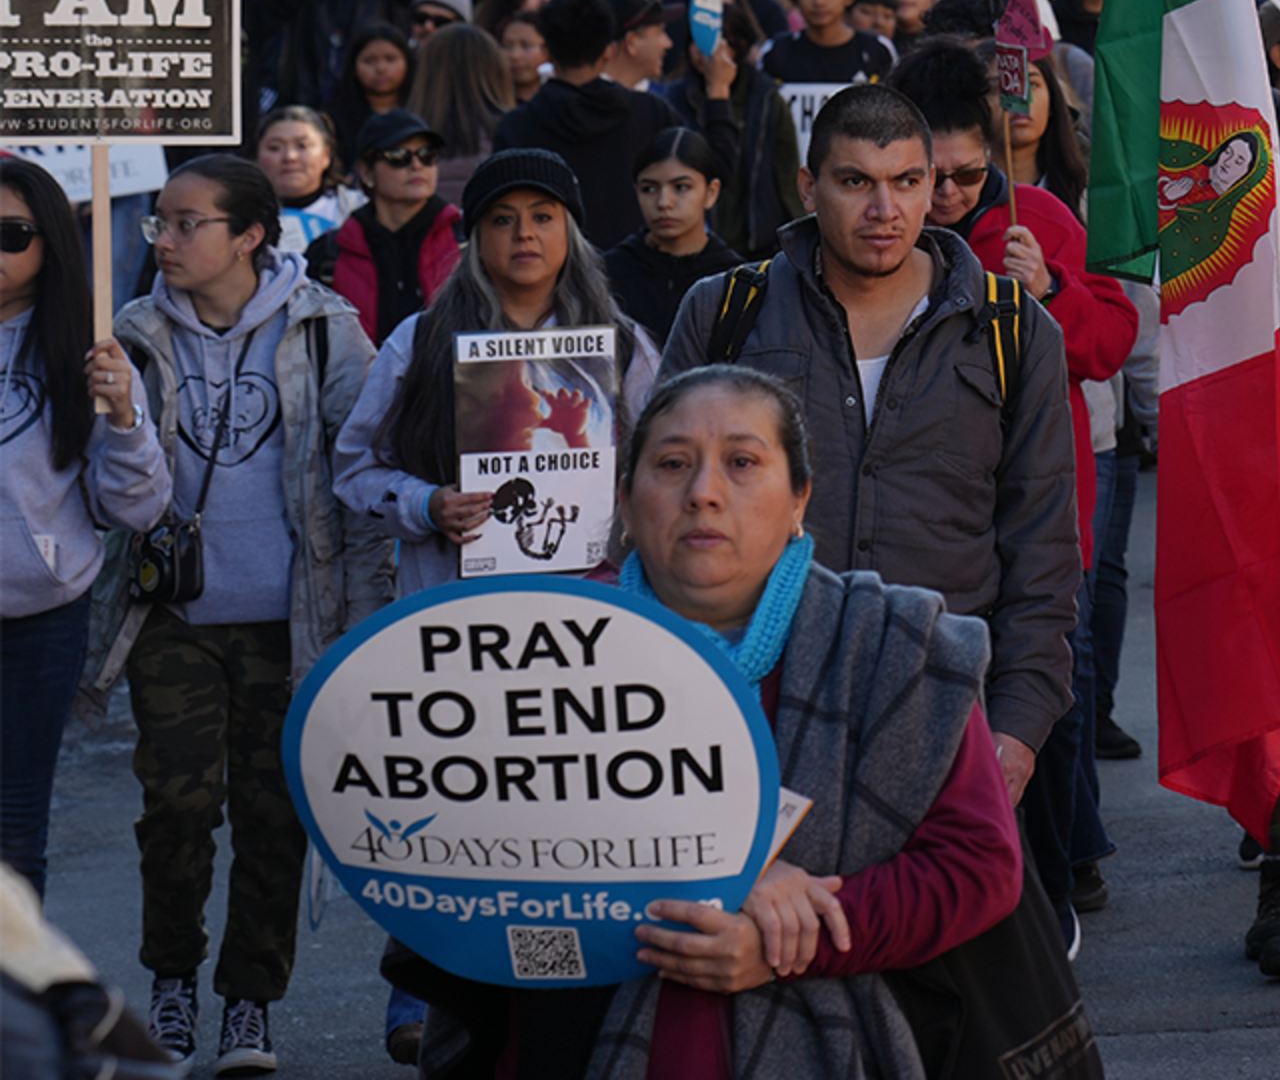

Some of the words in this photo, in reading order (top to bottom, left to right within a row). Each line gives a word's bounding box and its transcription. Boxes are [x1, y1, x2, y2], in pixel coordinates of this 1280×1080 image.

[85, 34, 113, 46] the
[0, 89, 212, 108] ENERATION
[468, 341, 481, 358] A
[485, 337, 547, 358] SILENT
[551, 334, 606, 355] VOICE
[477, 456, 513, 476] NOT
[518, 454, 529, 473] A
[535, 451, 600, 472] CHOICE
[419, 616, 613, 673] PRAY
[370, 690, 477, 739] TO
[505, 683, 667, 738] END
[332, 744, 726, 803] ABORTION
[349, 825, 413, 865] 40
[418, 835, 522, 869] DAYS
[530, 838, 617, 870] FOR
[624, 831, 721, 870] LIFE
